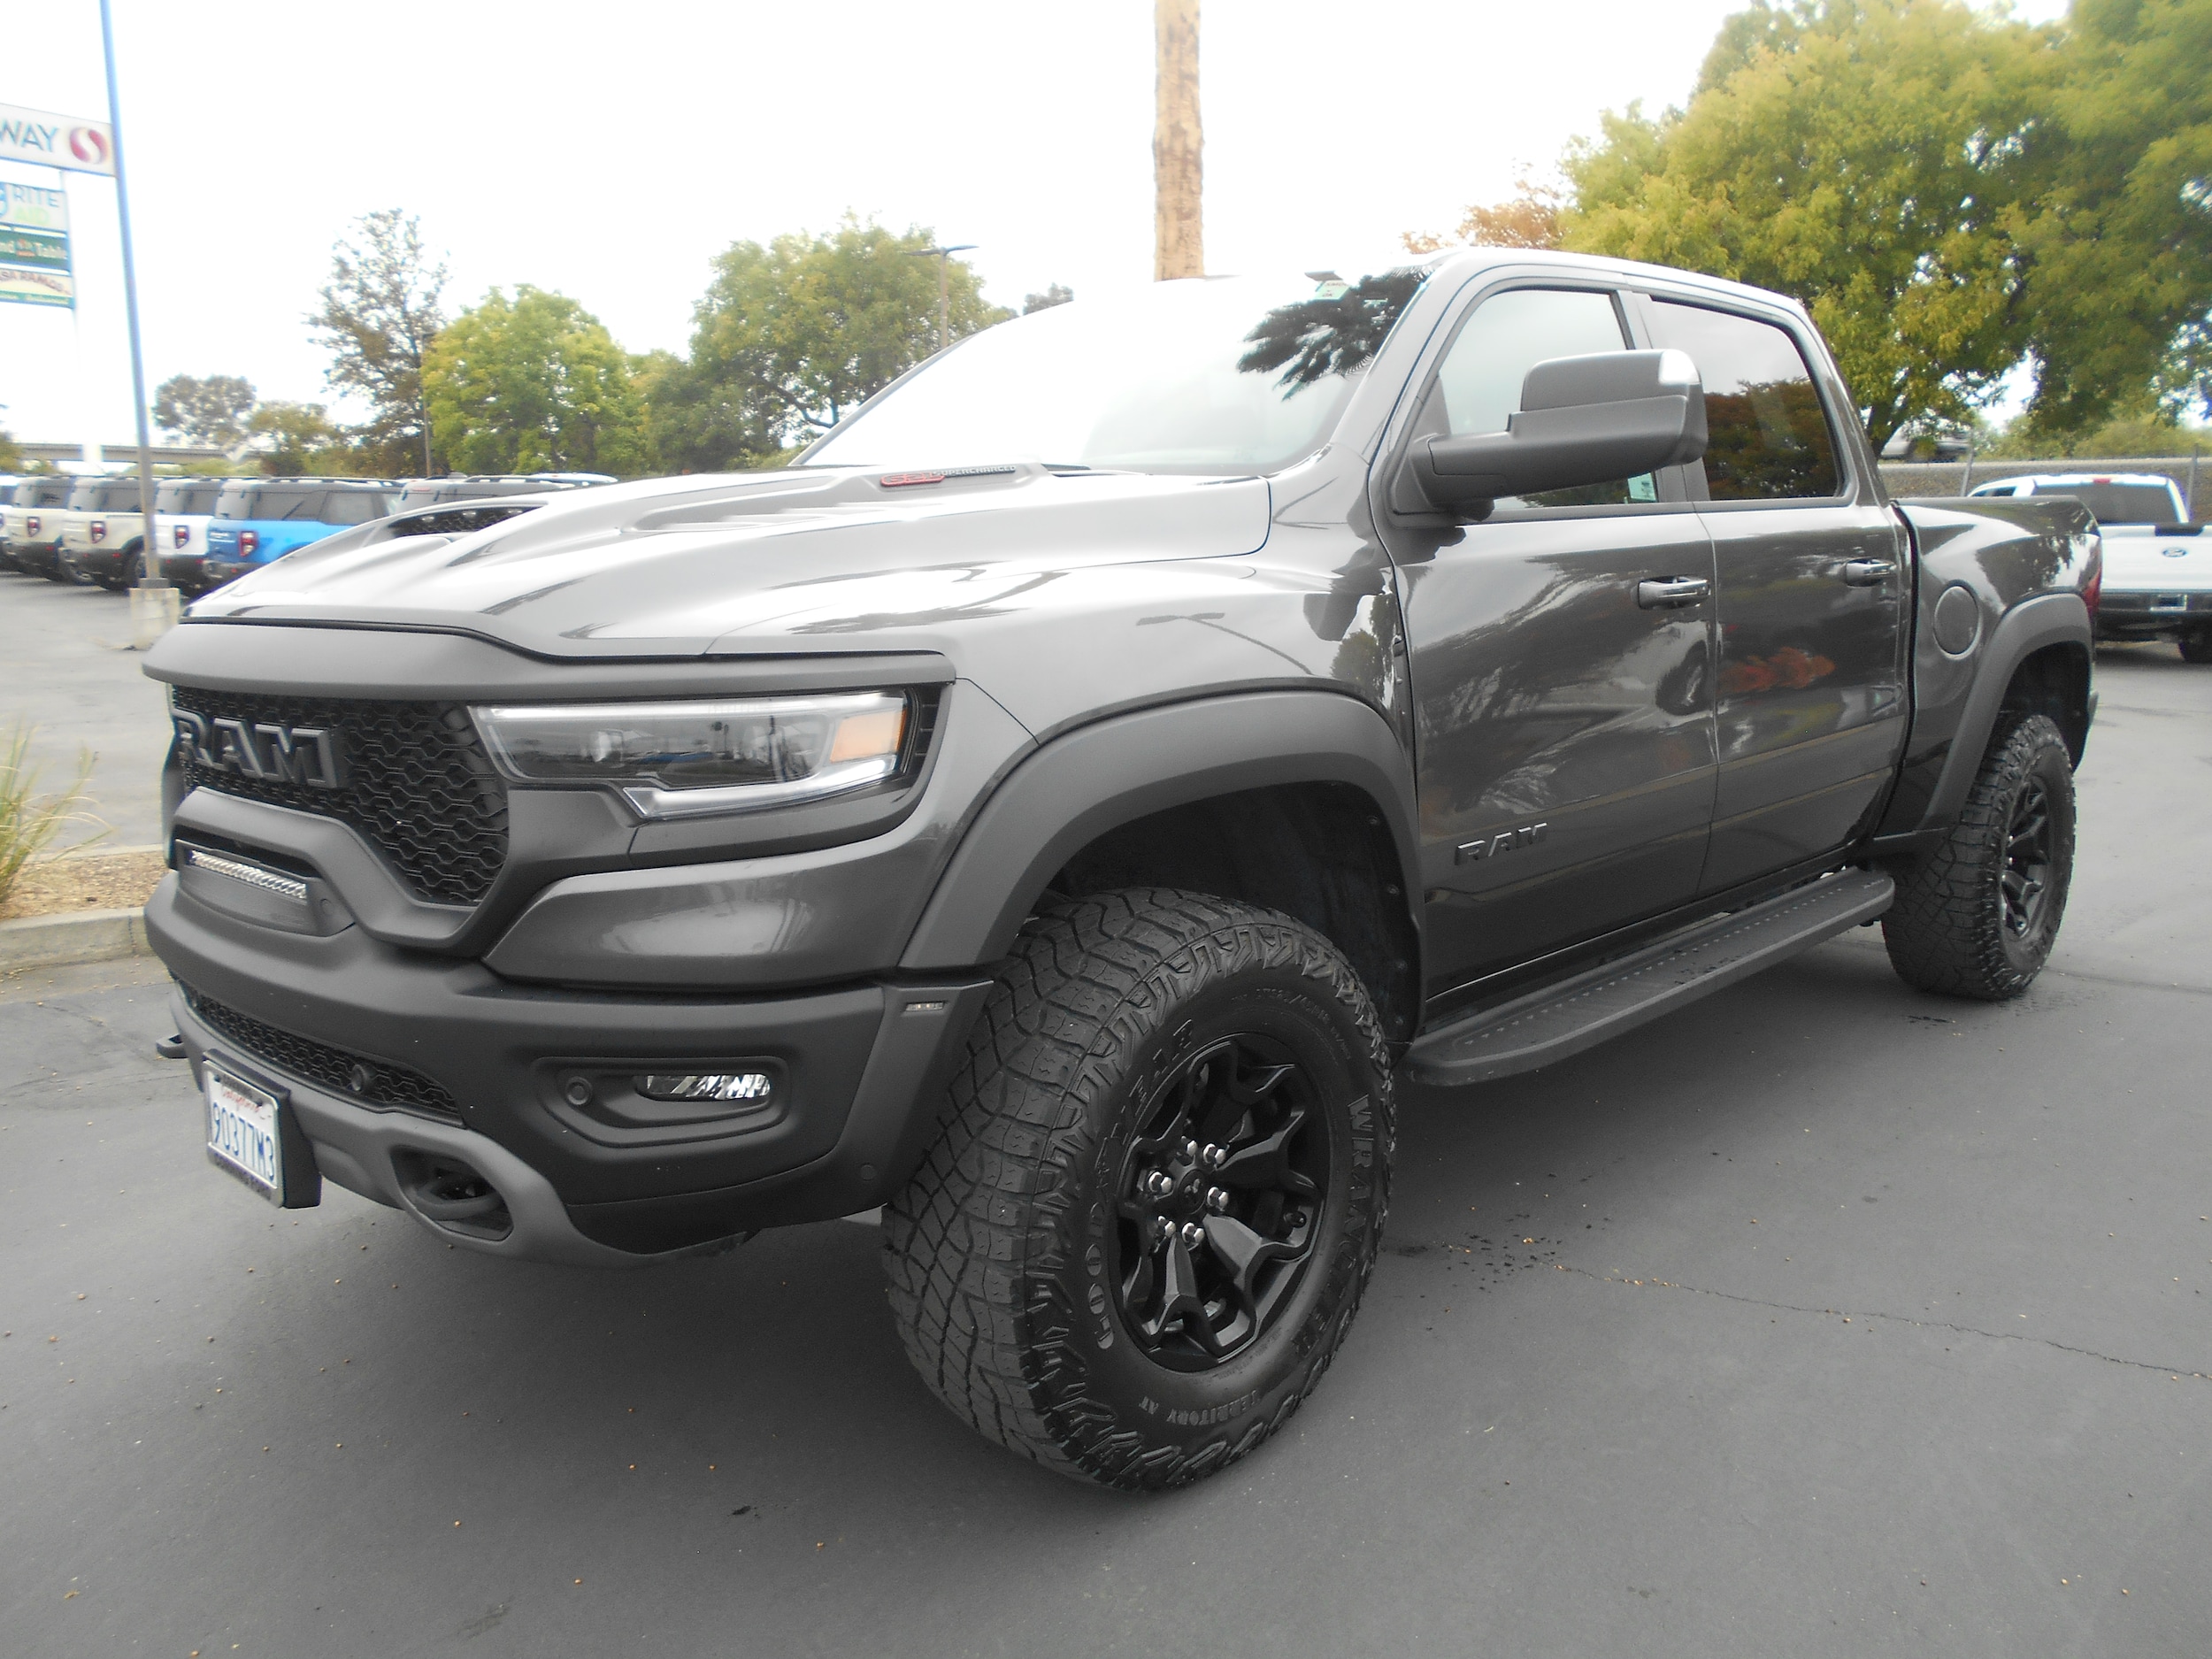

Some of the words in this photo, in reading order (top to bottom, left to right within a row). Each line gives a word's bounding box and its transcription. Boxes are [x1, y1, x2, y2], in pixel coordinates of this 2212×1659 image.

[12, 185, 59, 208] RITE
[14, 205, 50, 225] AID
[933, 465, 1016, 476] SUPERCHARGED
[172, 707, 338, 787] RAM
[1454, 822, 1548, 866] RAM
[1292, 1093, 1375, 1358] WRANGLER
[1138, 1395, 1160, 1416] AT
[1165, 1389, 1261, 1425] TERRITORY
